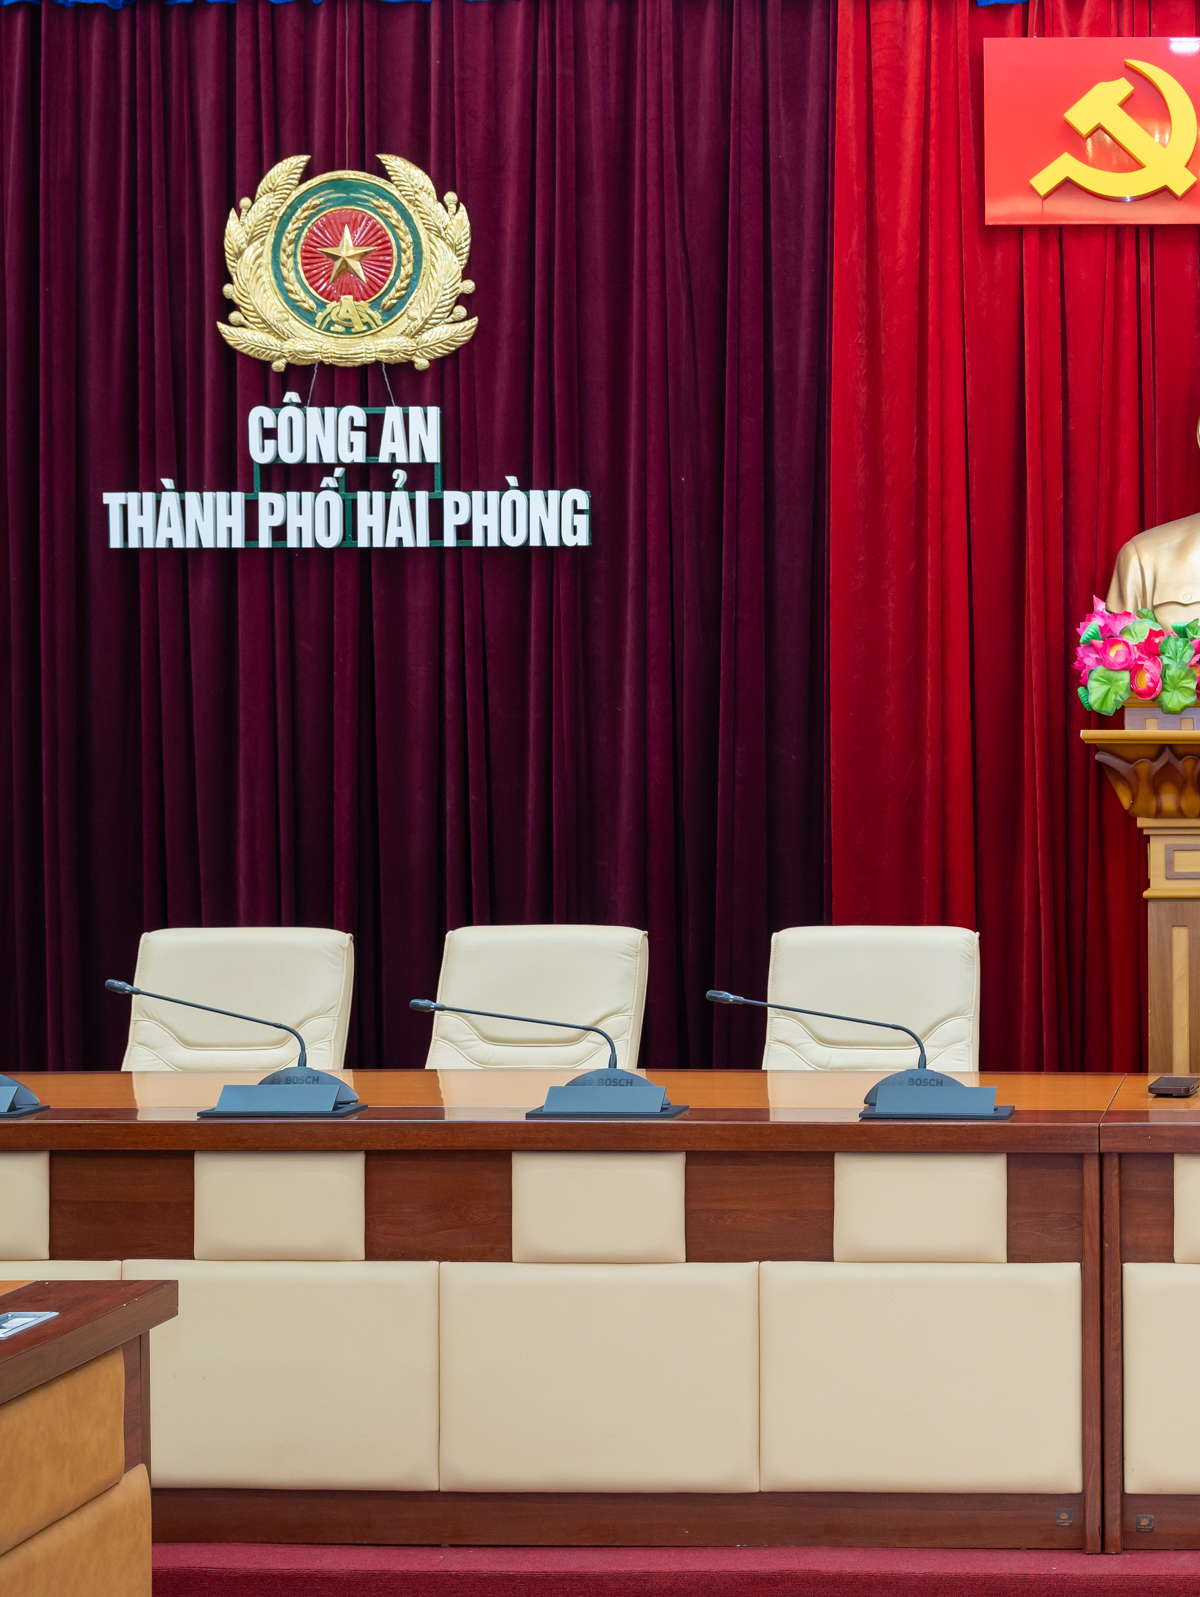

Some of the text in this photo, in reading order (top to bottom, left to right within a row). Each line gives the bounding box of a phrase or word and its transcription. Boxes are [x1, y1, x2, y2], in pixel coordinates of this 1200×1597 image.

[248, 391, 441, 464] CÔNG AN
[102, 467, 590, 548] THÀNH PHỐ HẢI PHÒNG
[285, 1075, 320, 1085] BOSCH
[597, 1077, 634, 1087] BOSCH
[907, 1077, 944, 1087] BOSCH
